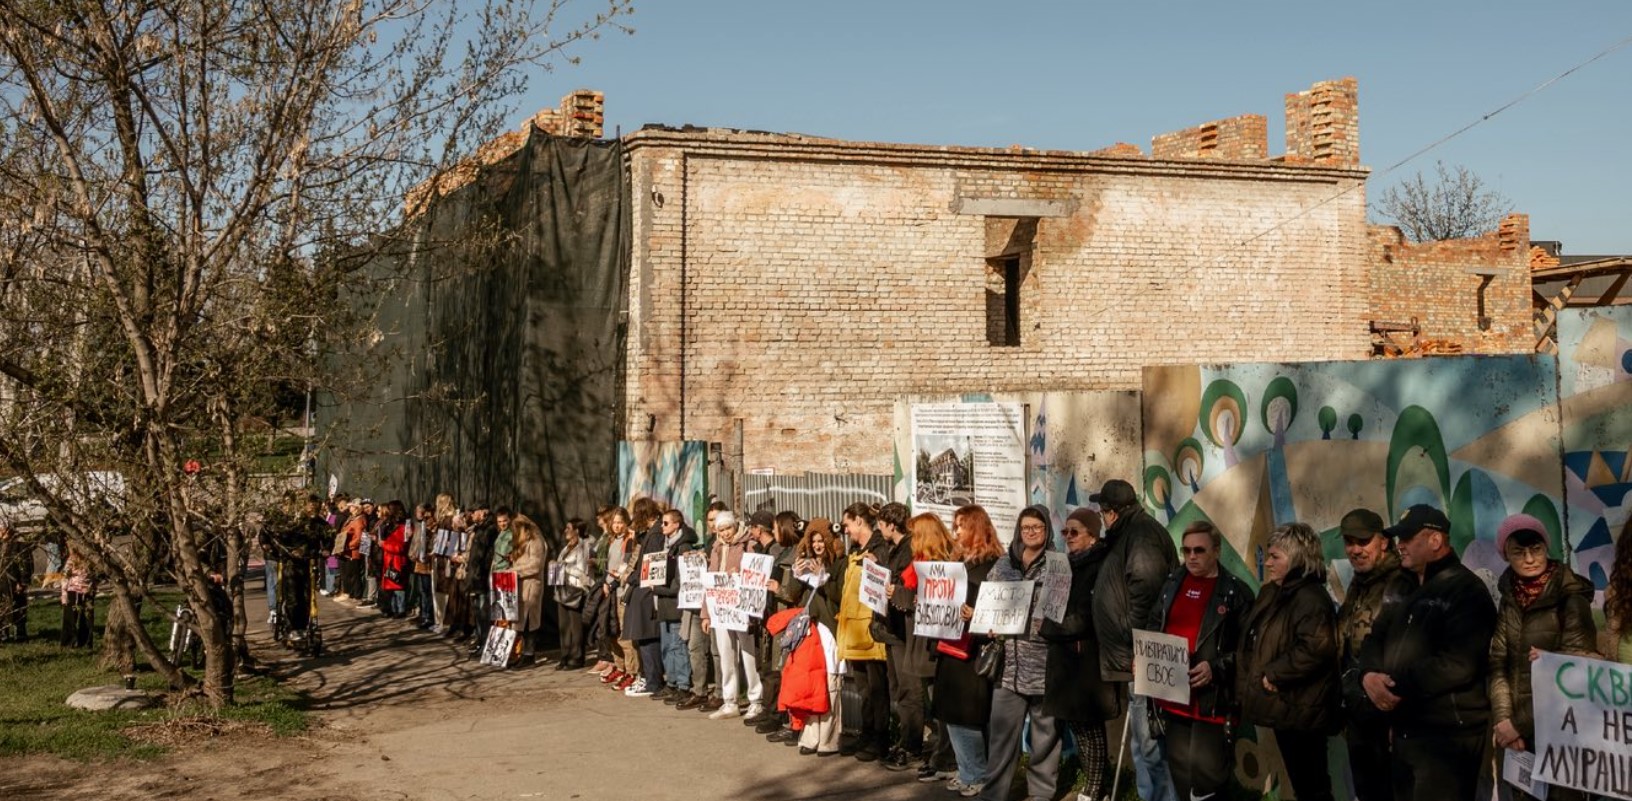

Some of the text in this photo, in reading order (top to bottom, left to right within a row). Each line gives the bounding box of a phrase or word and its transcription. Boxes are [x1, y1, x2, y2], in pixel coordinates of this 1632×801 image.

[923, 578, 956, 601] ПРОТИ
[1146, 662, 1176, 687] СВОЄ
[1556, 662, 1632, 706] СКВ
[1561, 706, 1632, 746] А НЕ
